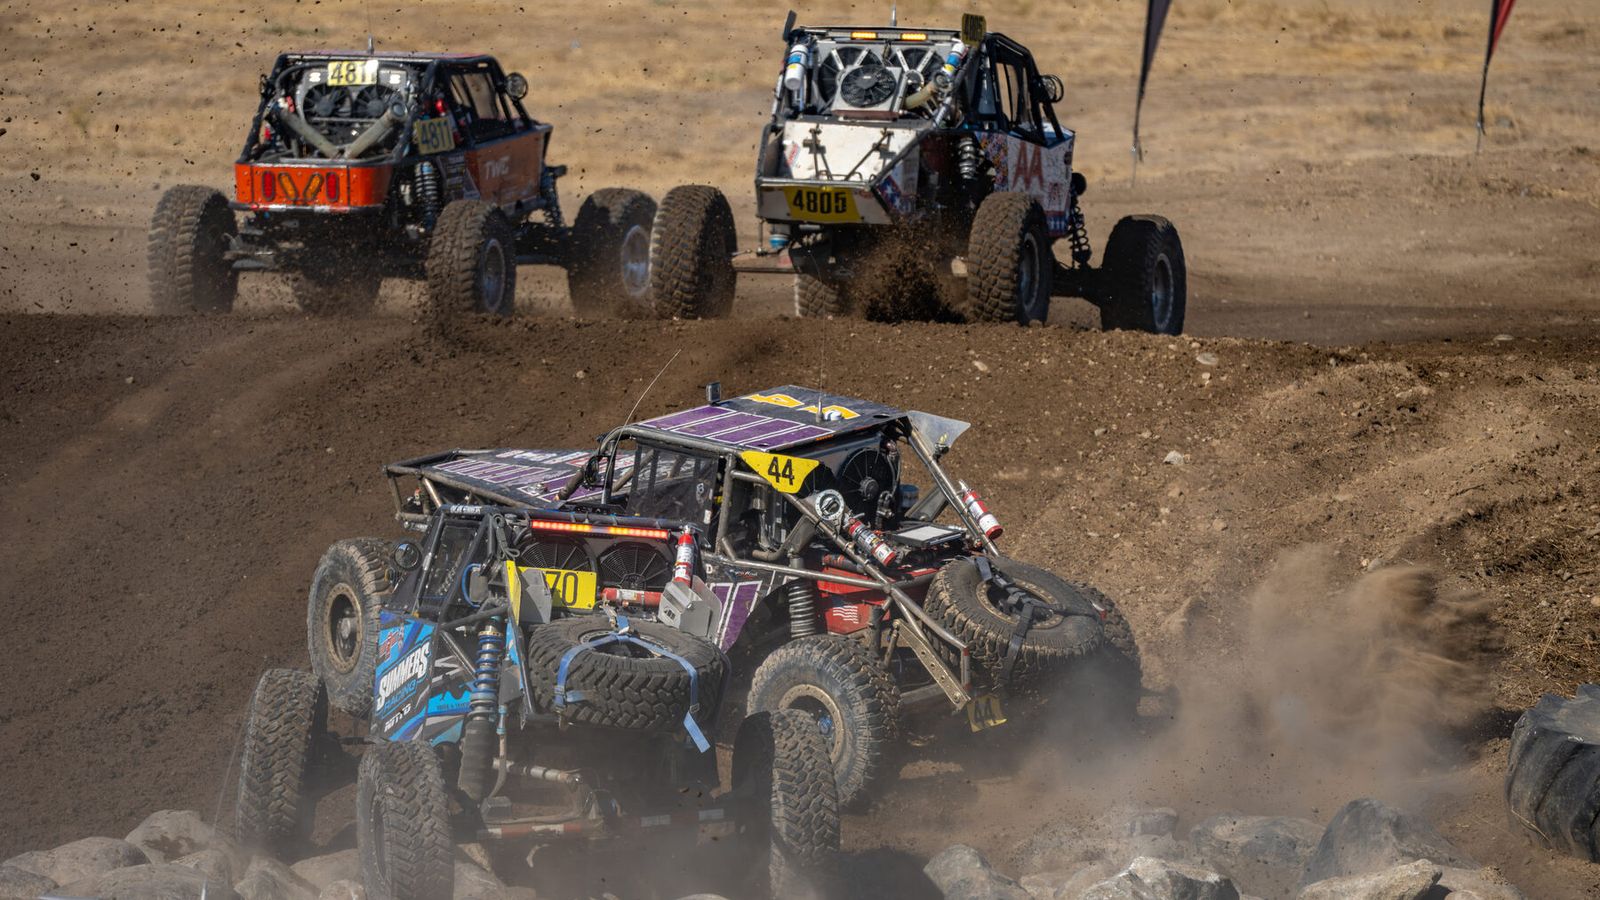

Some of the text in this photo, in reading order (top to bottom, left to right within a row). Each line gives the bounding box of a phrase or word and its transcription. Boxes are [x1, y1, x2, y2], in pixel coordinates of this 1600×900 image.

[420, 121, 453, 150] 4811
[1012, 141, 1044, 192] AA
[792, 189, 847, 214] 4805
[768, 456, 795, 486] 44
[376, 641, 430, 712] SUMMERS
